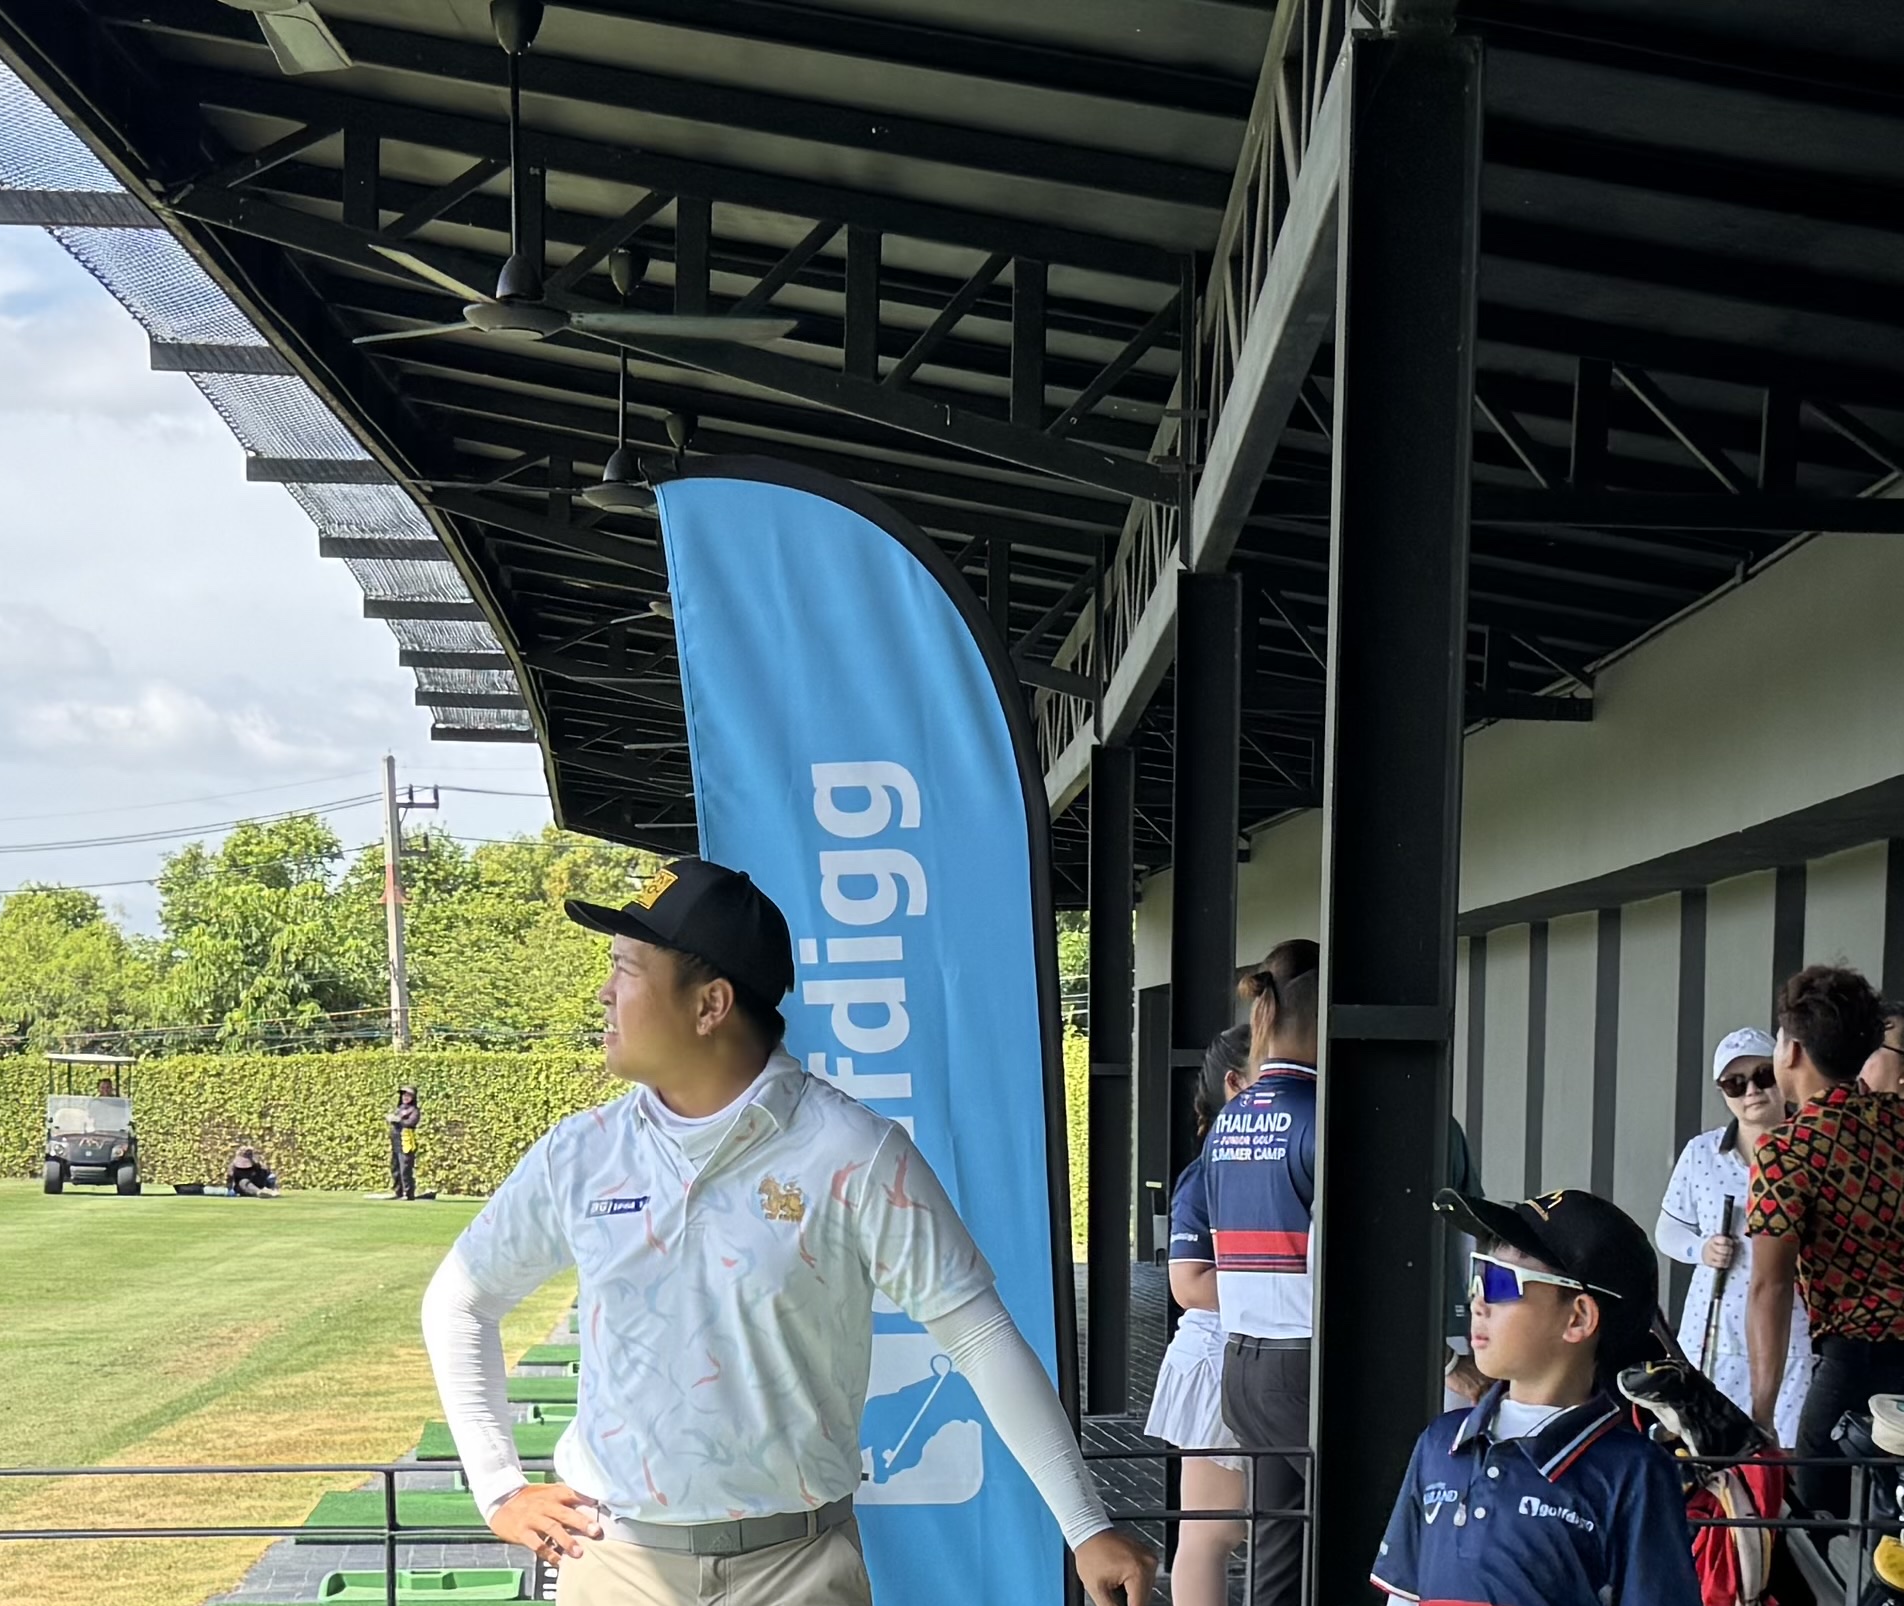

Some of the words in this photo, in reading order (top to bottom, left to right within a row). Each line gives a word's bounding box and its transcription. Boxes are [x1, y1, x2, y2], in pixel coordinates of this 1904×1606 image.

[799, 761, 928, 1312] fdigg
[1215, 1112, 1292, 1134] THAILAND
[1254, 1147, 1286, 1161] CAMP
